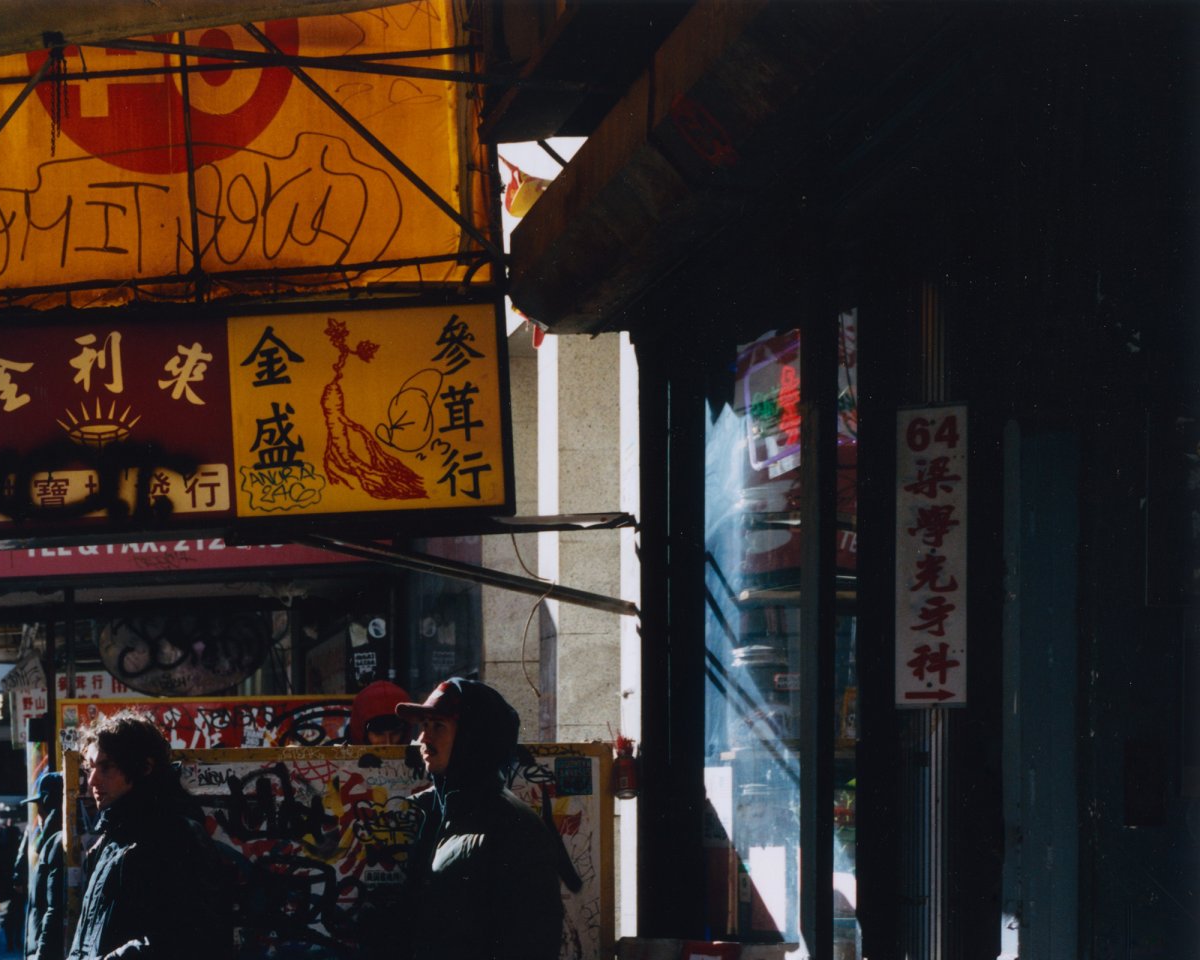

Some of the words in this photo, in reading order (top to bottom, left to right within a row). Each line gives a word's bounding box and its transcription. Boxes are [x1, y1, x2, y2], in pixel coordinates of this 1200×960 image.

[240, 326, 305, 470] 金盛
[431, 314, 492, 499] 參茸行
[906, 415, 959, 452] 64
[904, 457, 961, 685] 梁學光牙科
